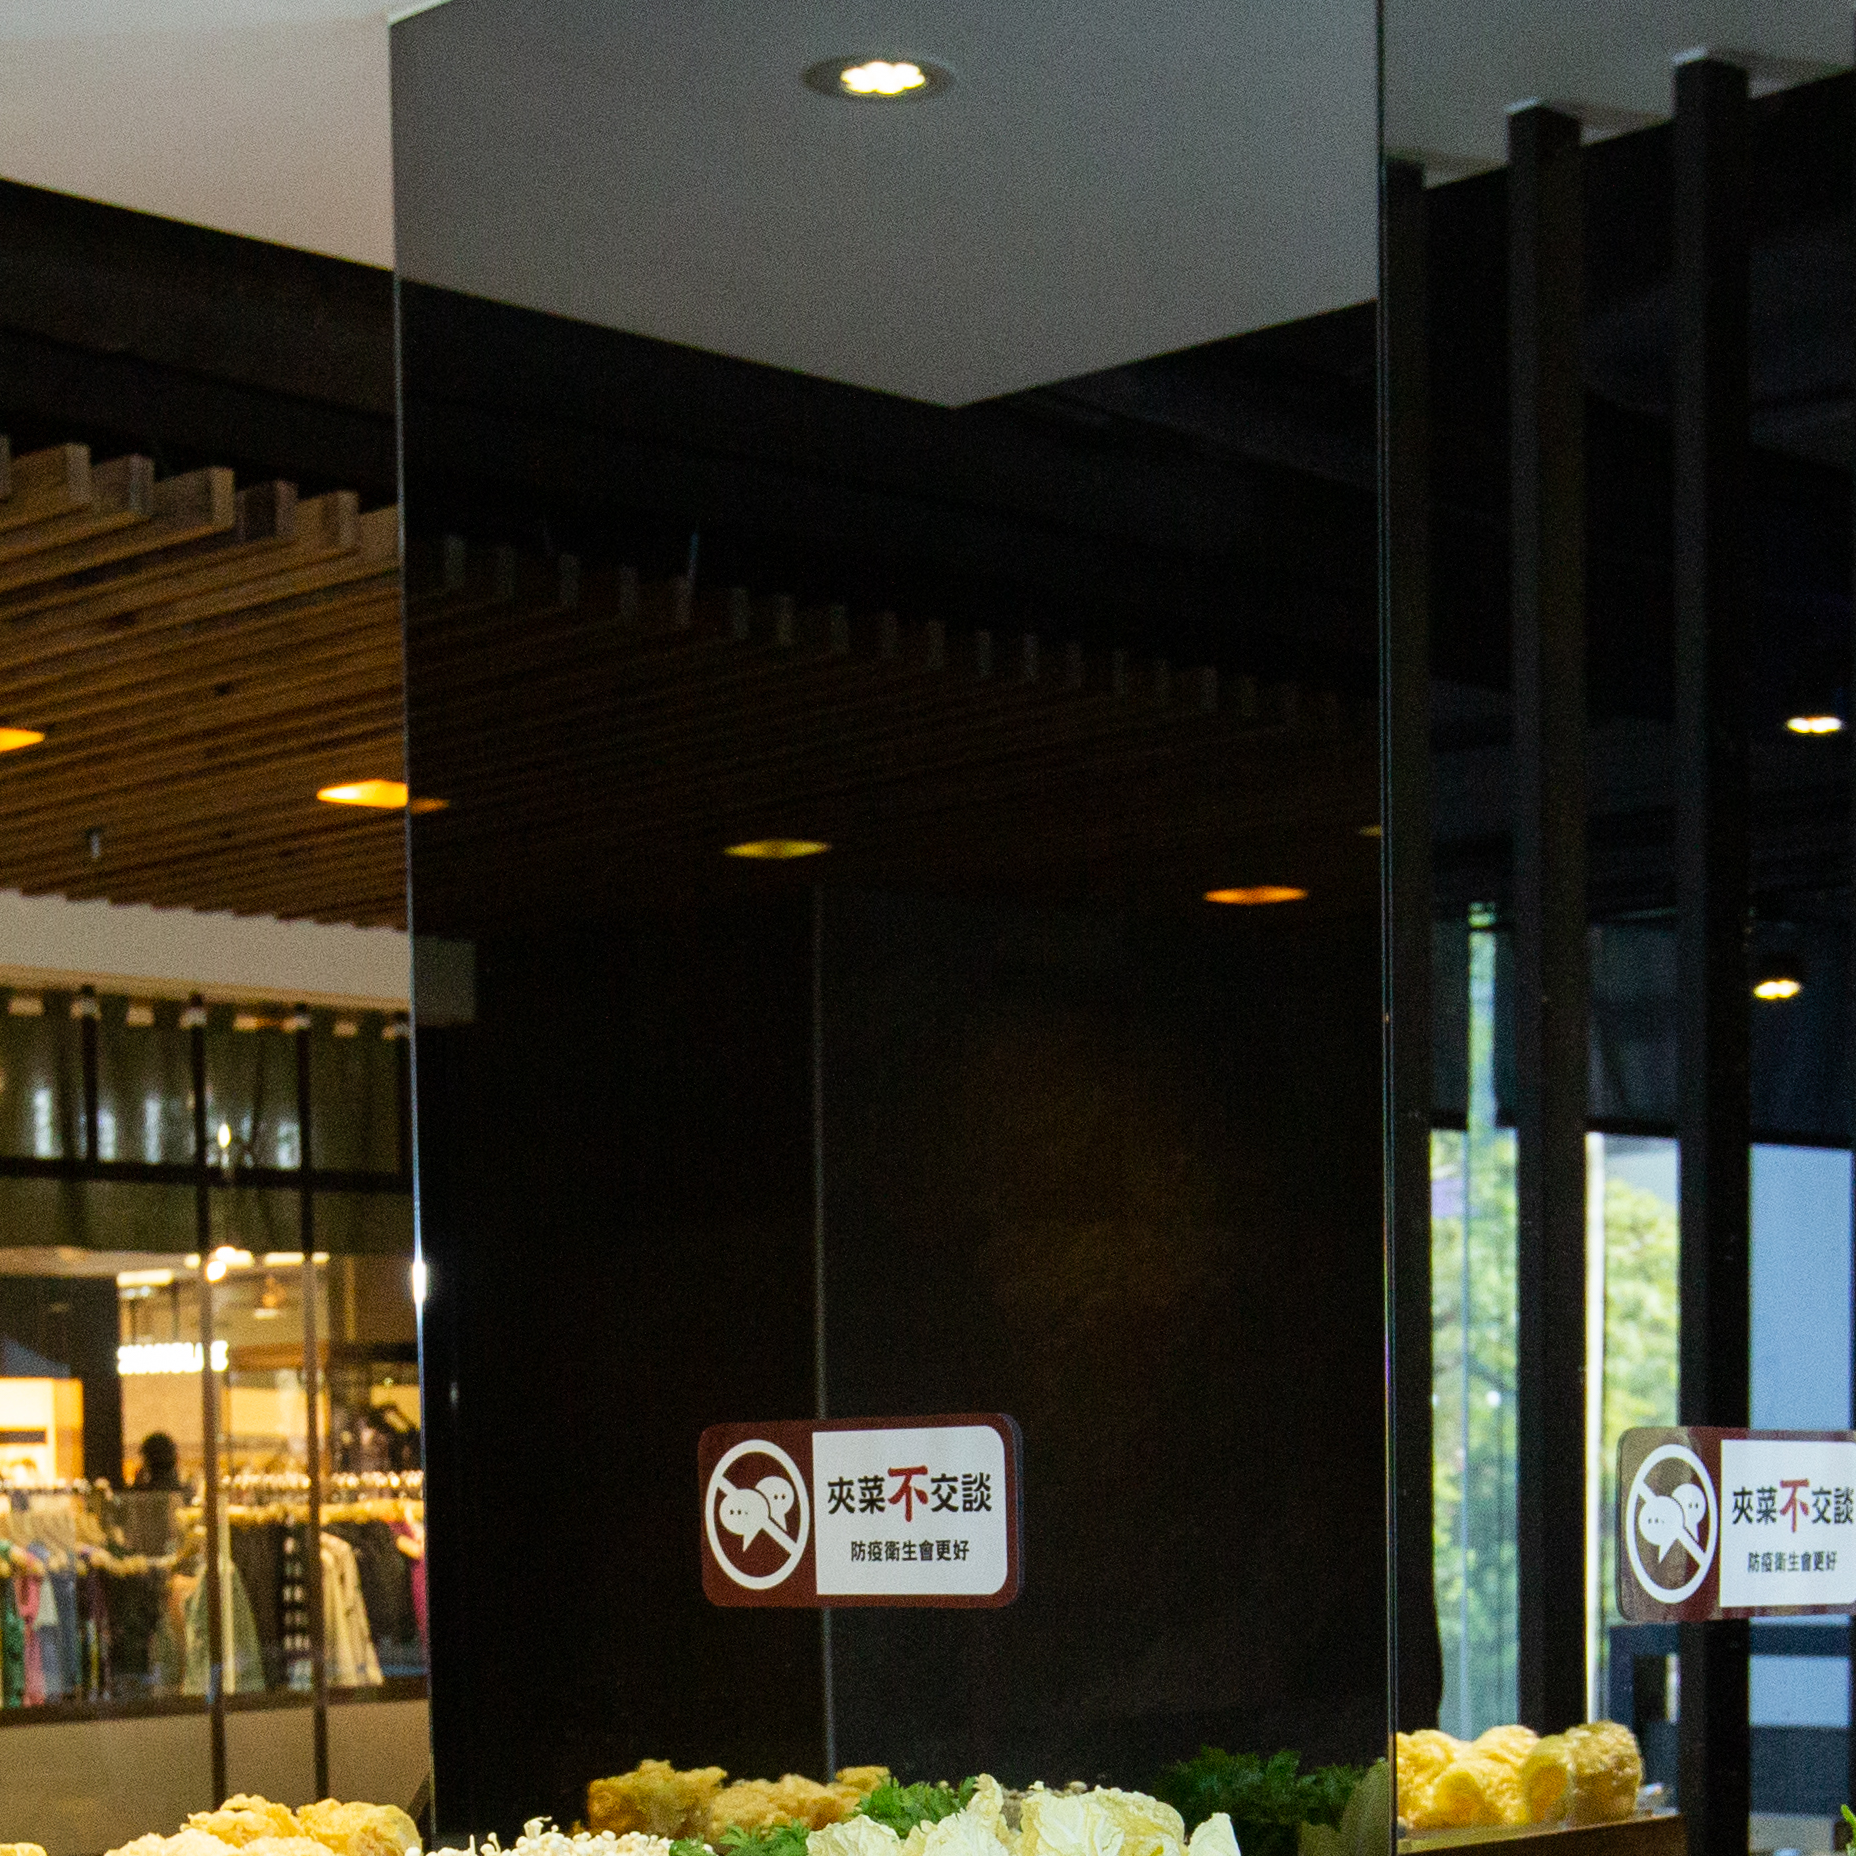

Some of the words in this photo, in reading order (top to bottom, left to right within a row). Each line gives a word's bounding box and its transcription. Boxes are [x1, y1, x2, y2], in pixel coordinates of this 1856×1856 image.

[827, 1466, 992, 1523] 夾菜不交談
[1732, 1479, 1854, 1533] 夾菜不交談
[850, 1539, 970, 1562] 防疫衛生會更好
[1747, 1551, 1838, 1573] 防疫衛生會更好
